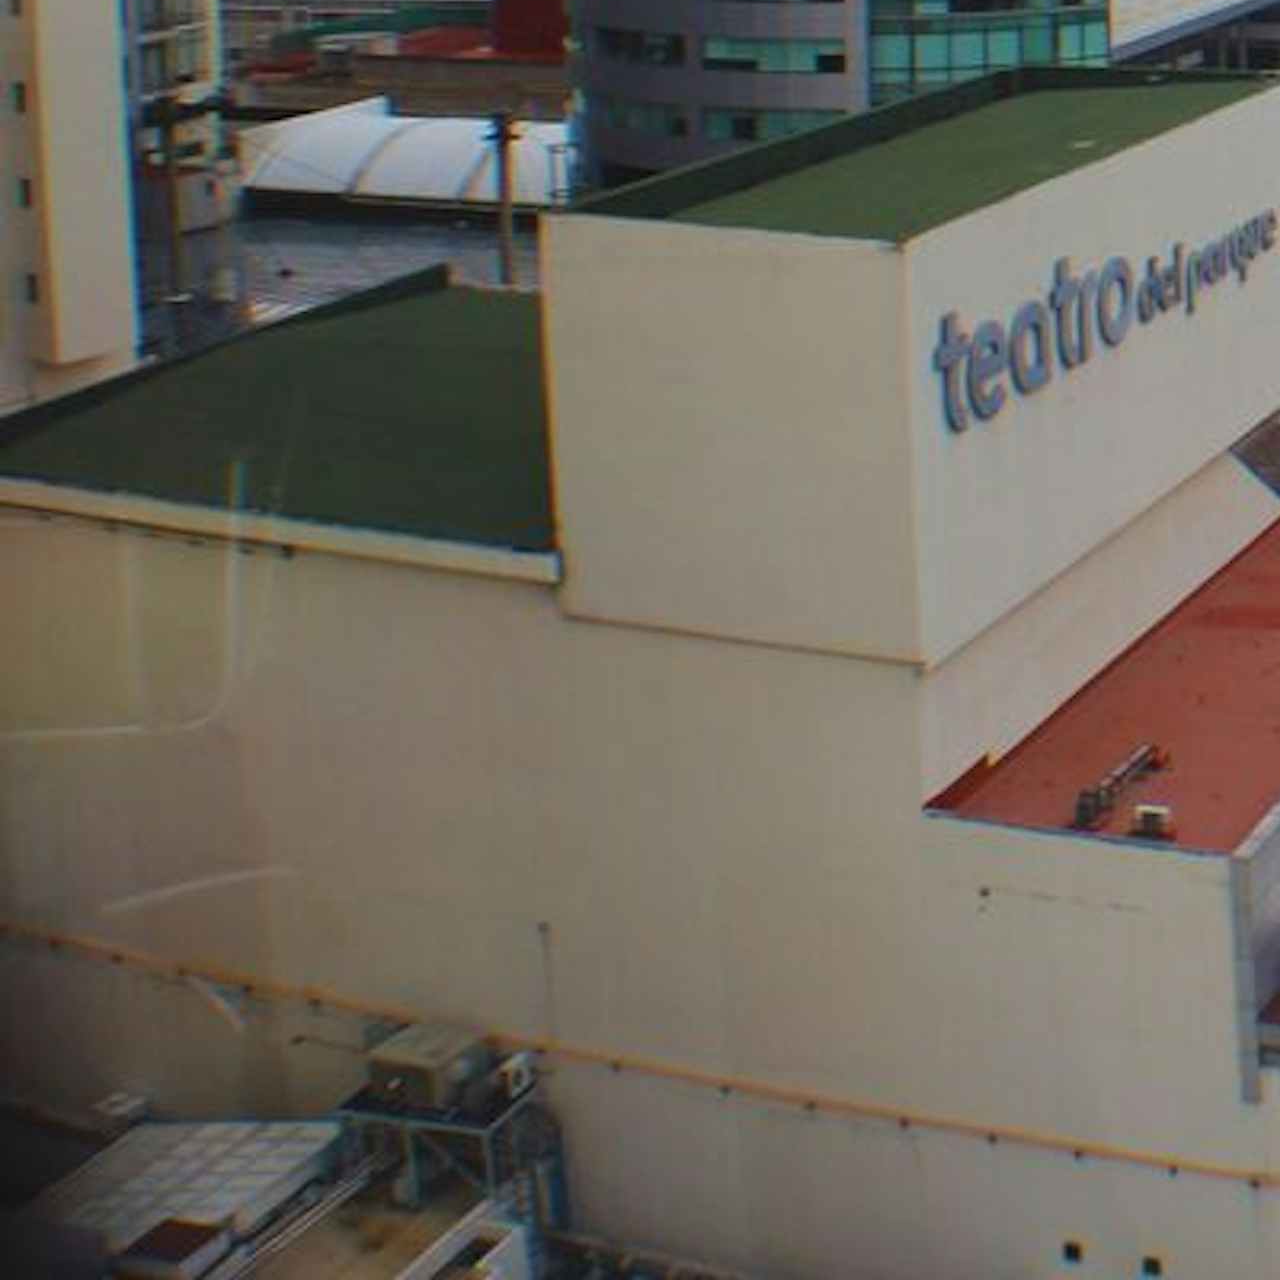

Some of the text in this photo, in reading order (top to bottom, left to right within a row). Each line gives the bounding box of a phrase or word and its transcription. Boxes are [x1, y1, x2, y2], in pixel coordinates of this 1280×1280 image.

[933, 207, 1278, 435] teatro del parque
